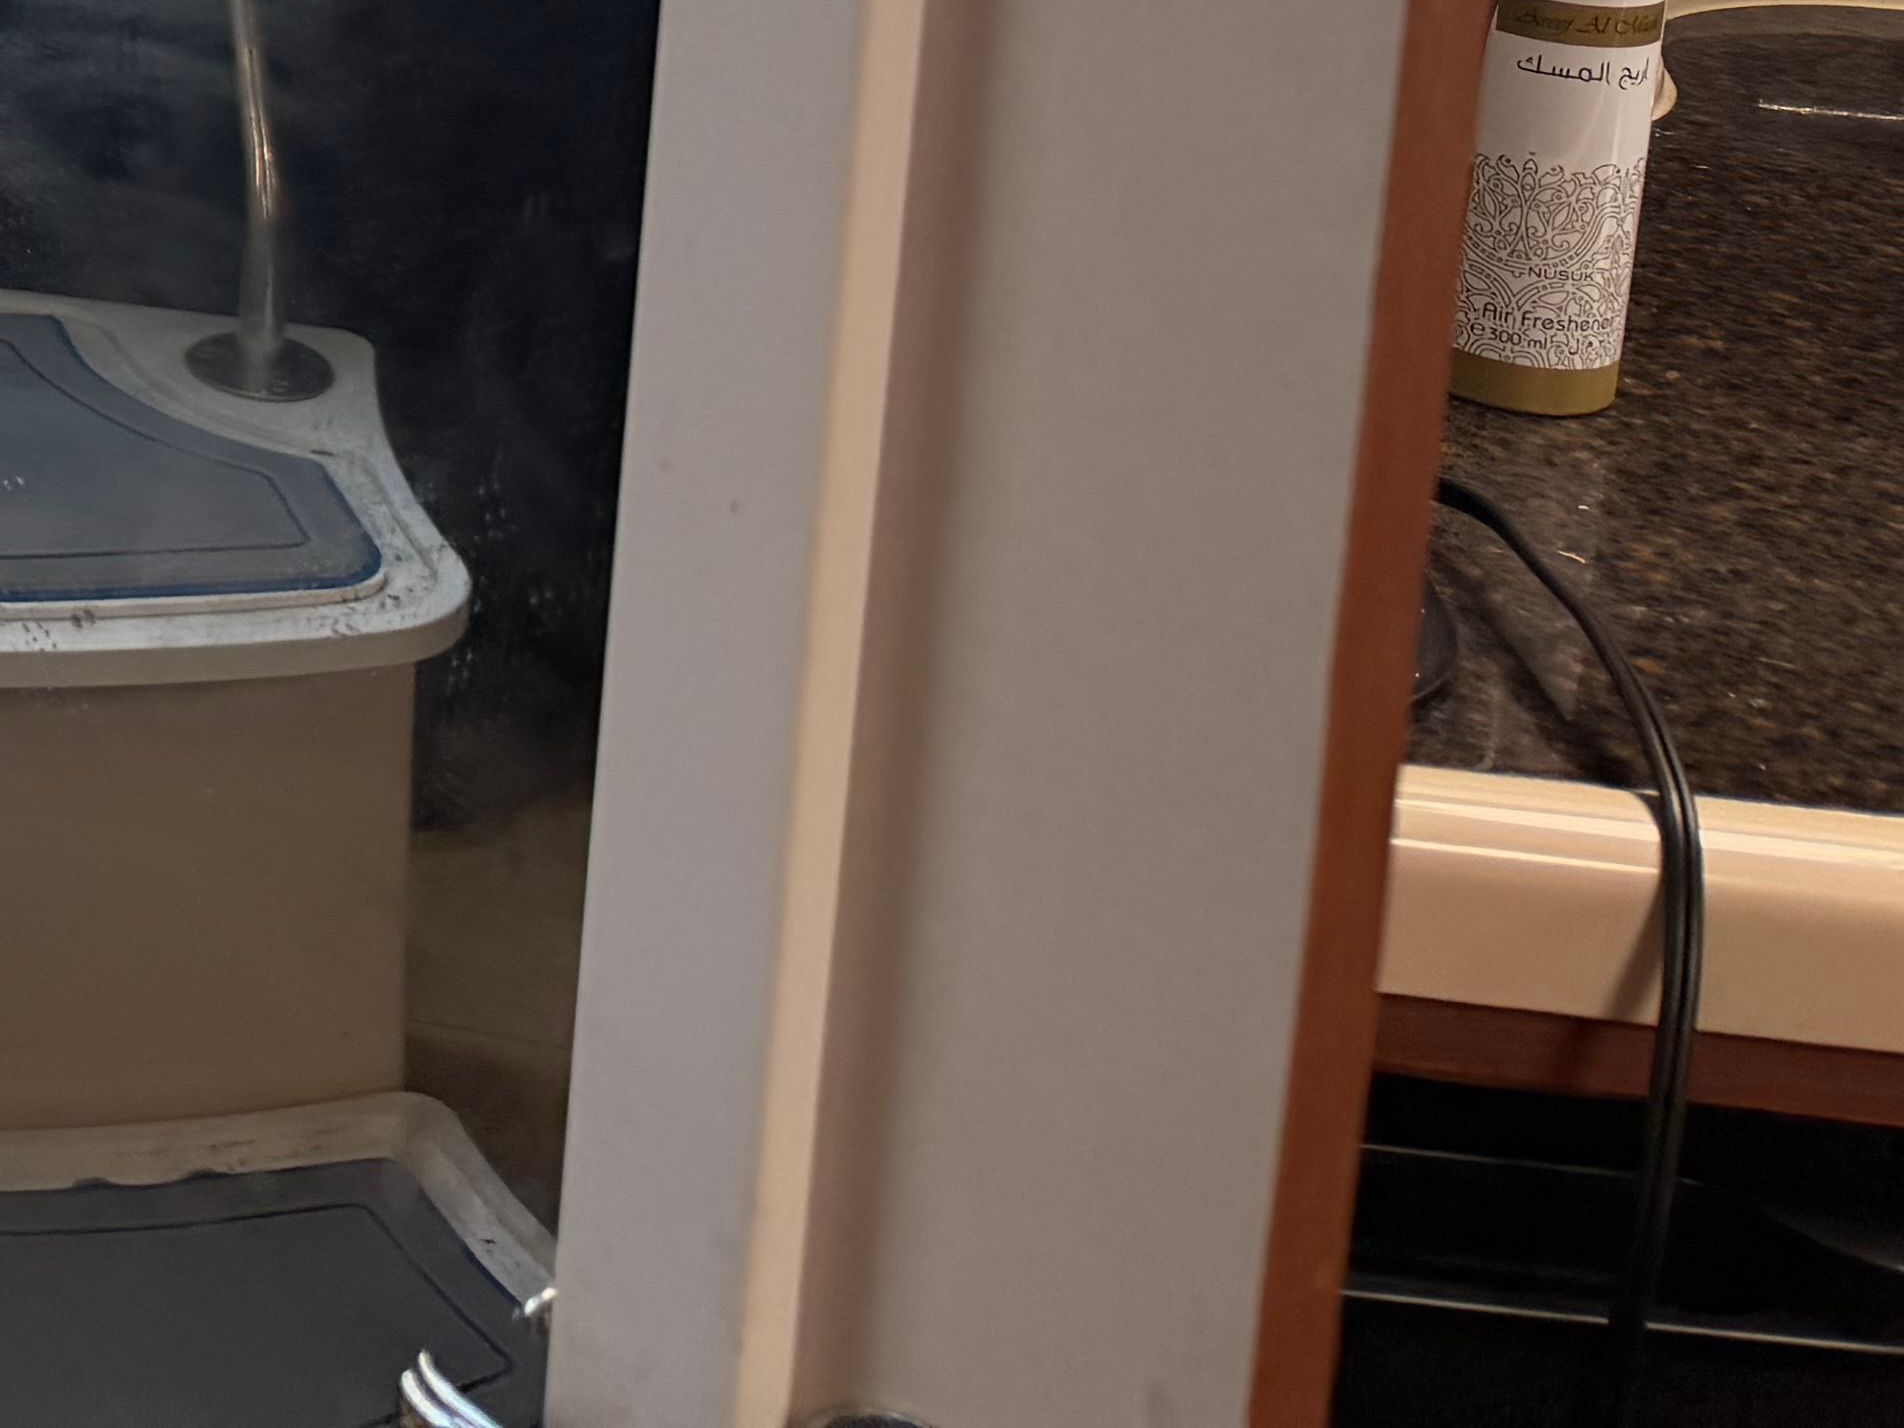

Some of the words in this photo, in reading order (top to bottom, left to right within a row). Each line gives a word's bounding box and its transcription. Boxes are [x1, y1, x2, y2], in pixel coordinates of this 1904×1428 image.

[1516, 54, 1611, 85] المسك
[1527, 266, 1595, 282] NUSUK
[1482, 301, 1513, 324] Air
[1521, 310, 1614, 332] Freshener
[1489, 329, 1522, 346] 300
[1527, 336, 1547, 350] ml
